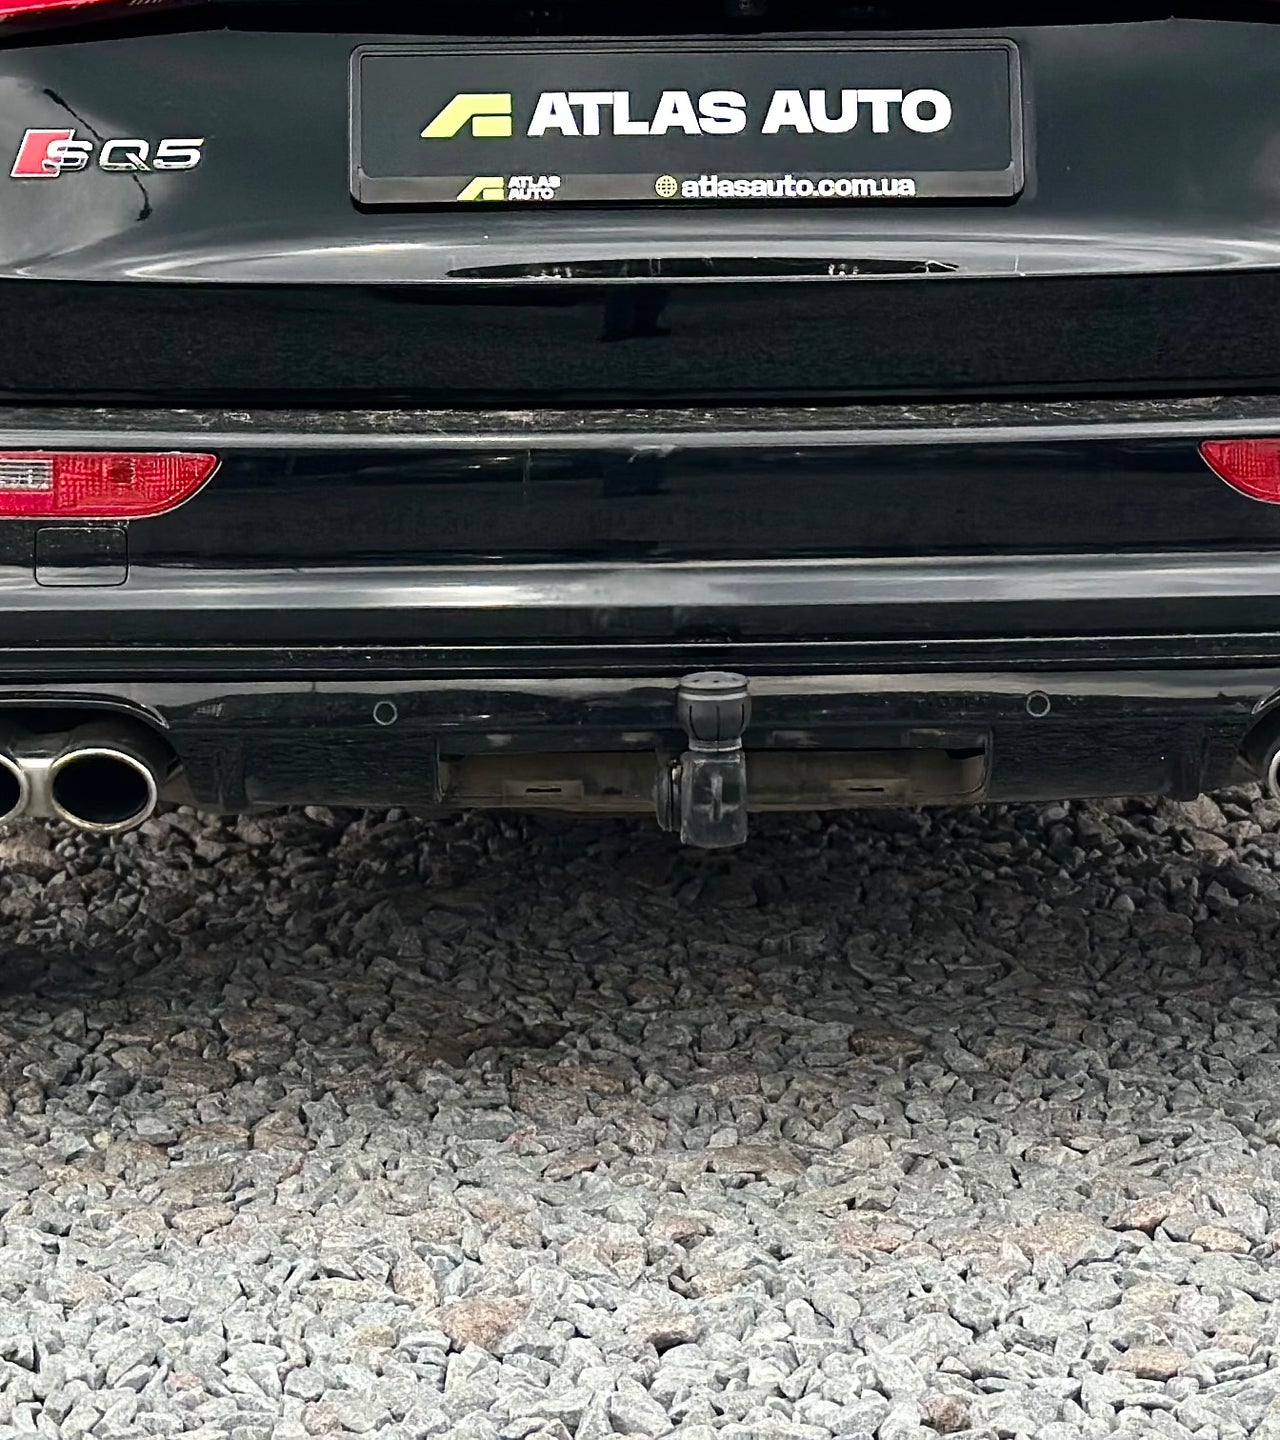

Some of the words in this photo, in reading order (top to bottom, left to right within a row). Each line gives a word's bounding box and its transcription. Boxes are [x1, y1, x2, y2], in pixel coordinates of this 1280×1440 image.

[527, 90, 748, 137] ATLAS
[761, 88, 952, 135] AUTO
[38, 136, 205, 173] SQ5
[508, 175, 561, 188] ATLAS
[508, 187, 555, 200] AUTO
[681, 174, 916, 198] atlasauto.com.ua
